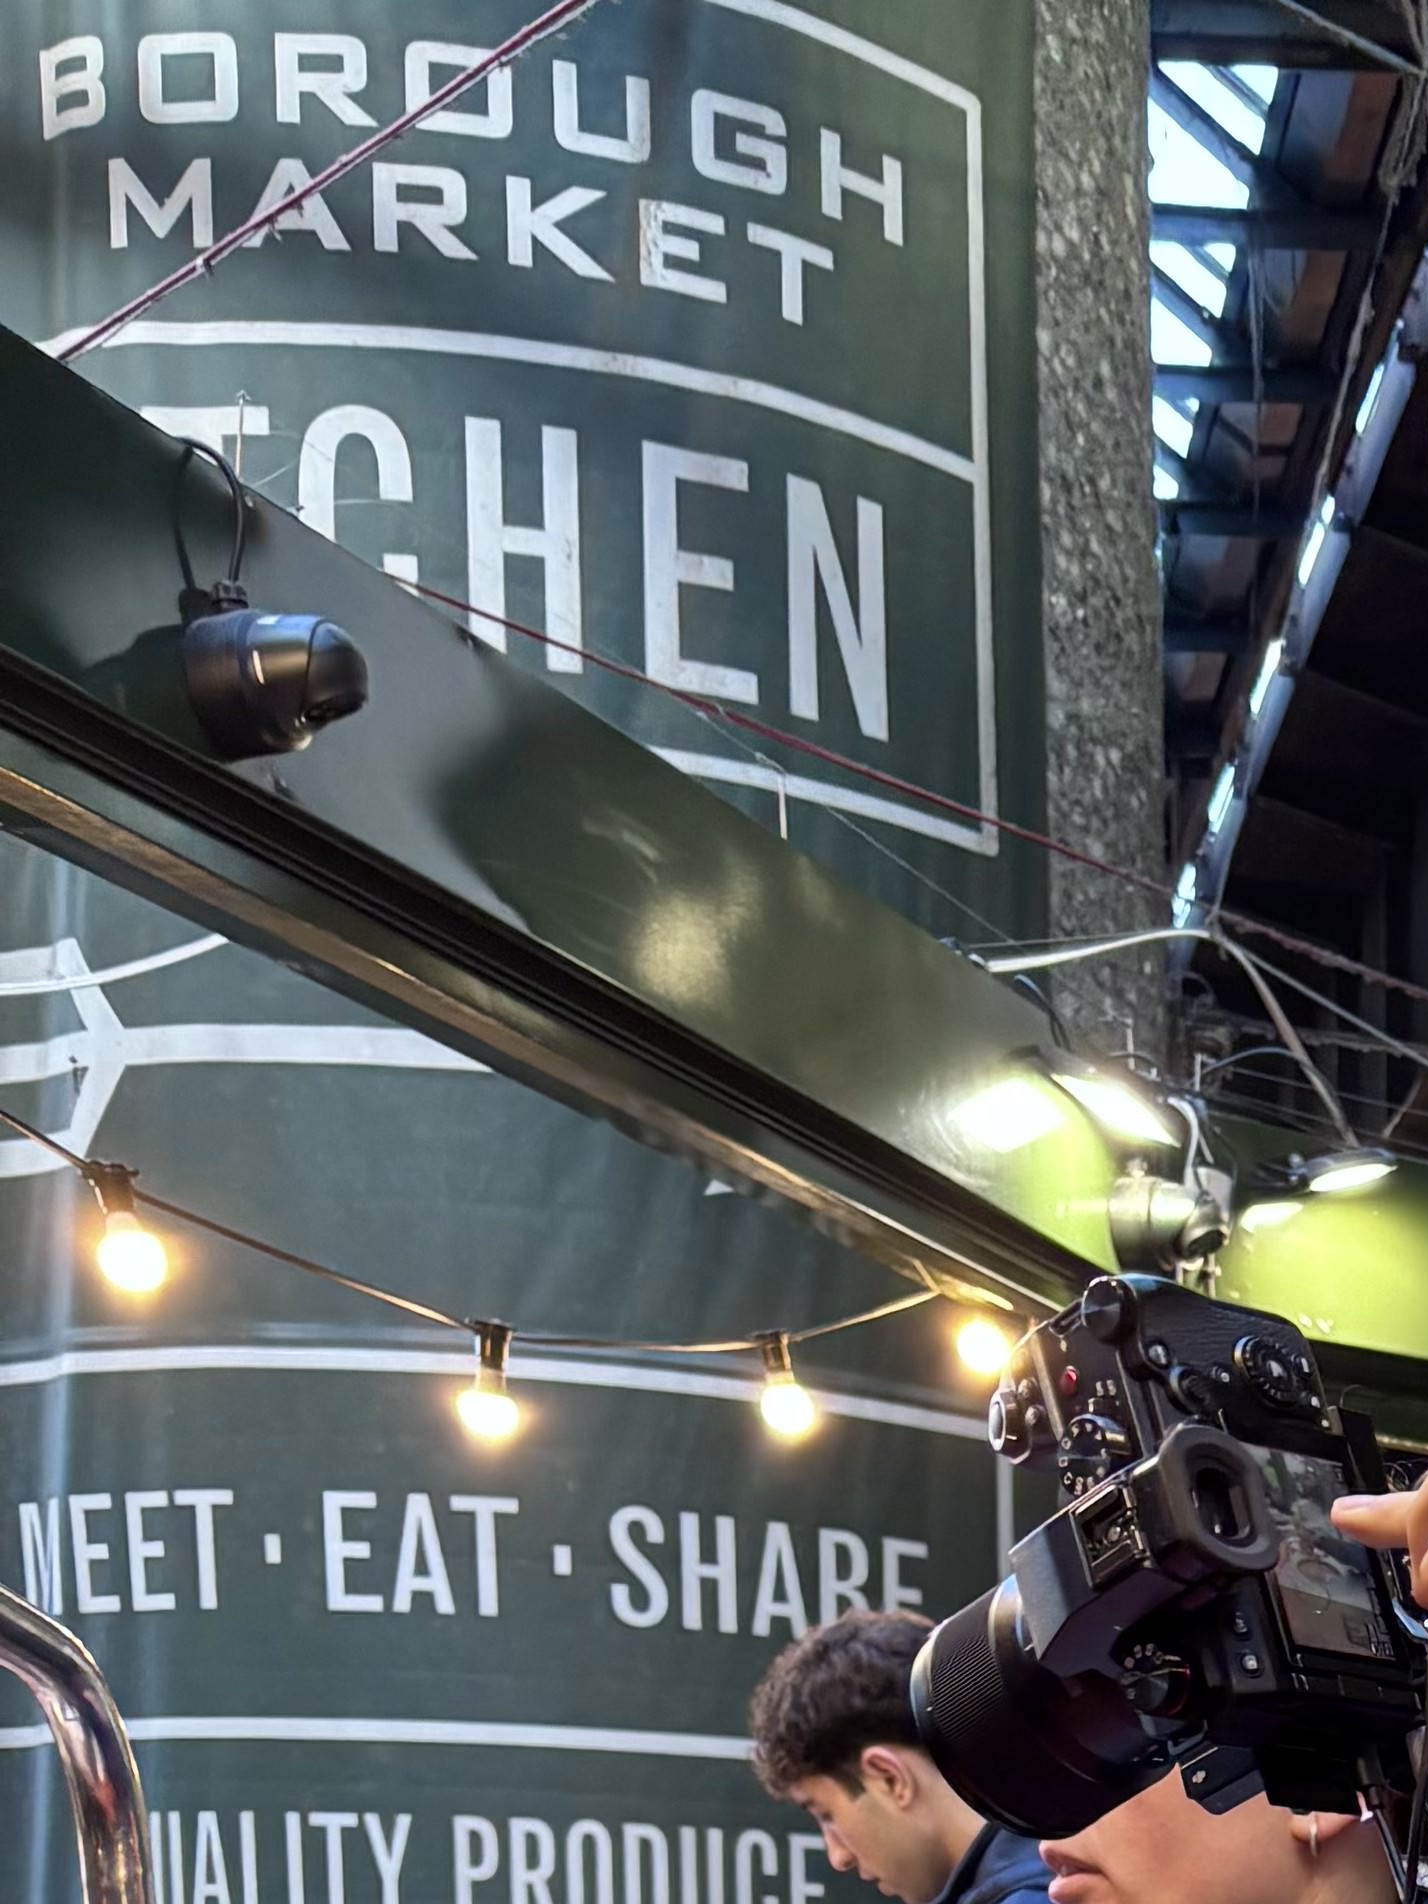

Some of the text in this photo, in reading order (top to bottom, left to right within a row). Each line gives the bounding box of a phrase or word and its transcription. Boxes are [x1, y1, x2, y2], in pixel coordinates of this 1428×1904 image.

[40, 32, 904, 246] BOROUGH
[108, 157, 833, 325] MARKET
[19, 1489, 928, 1639] MEET EAT SHARE
